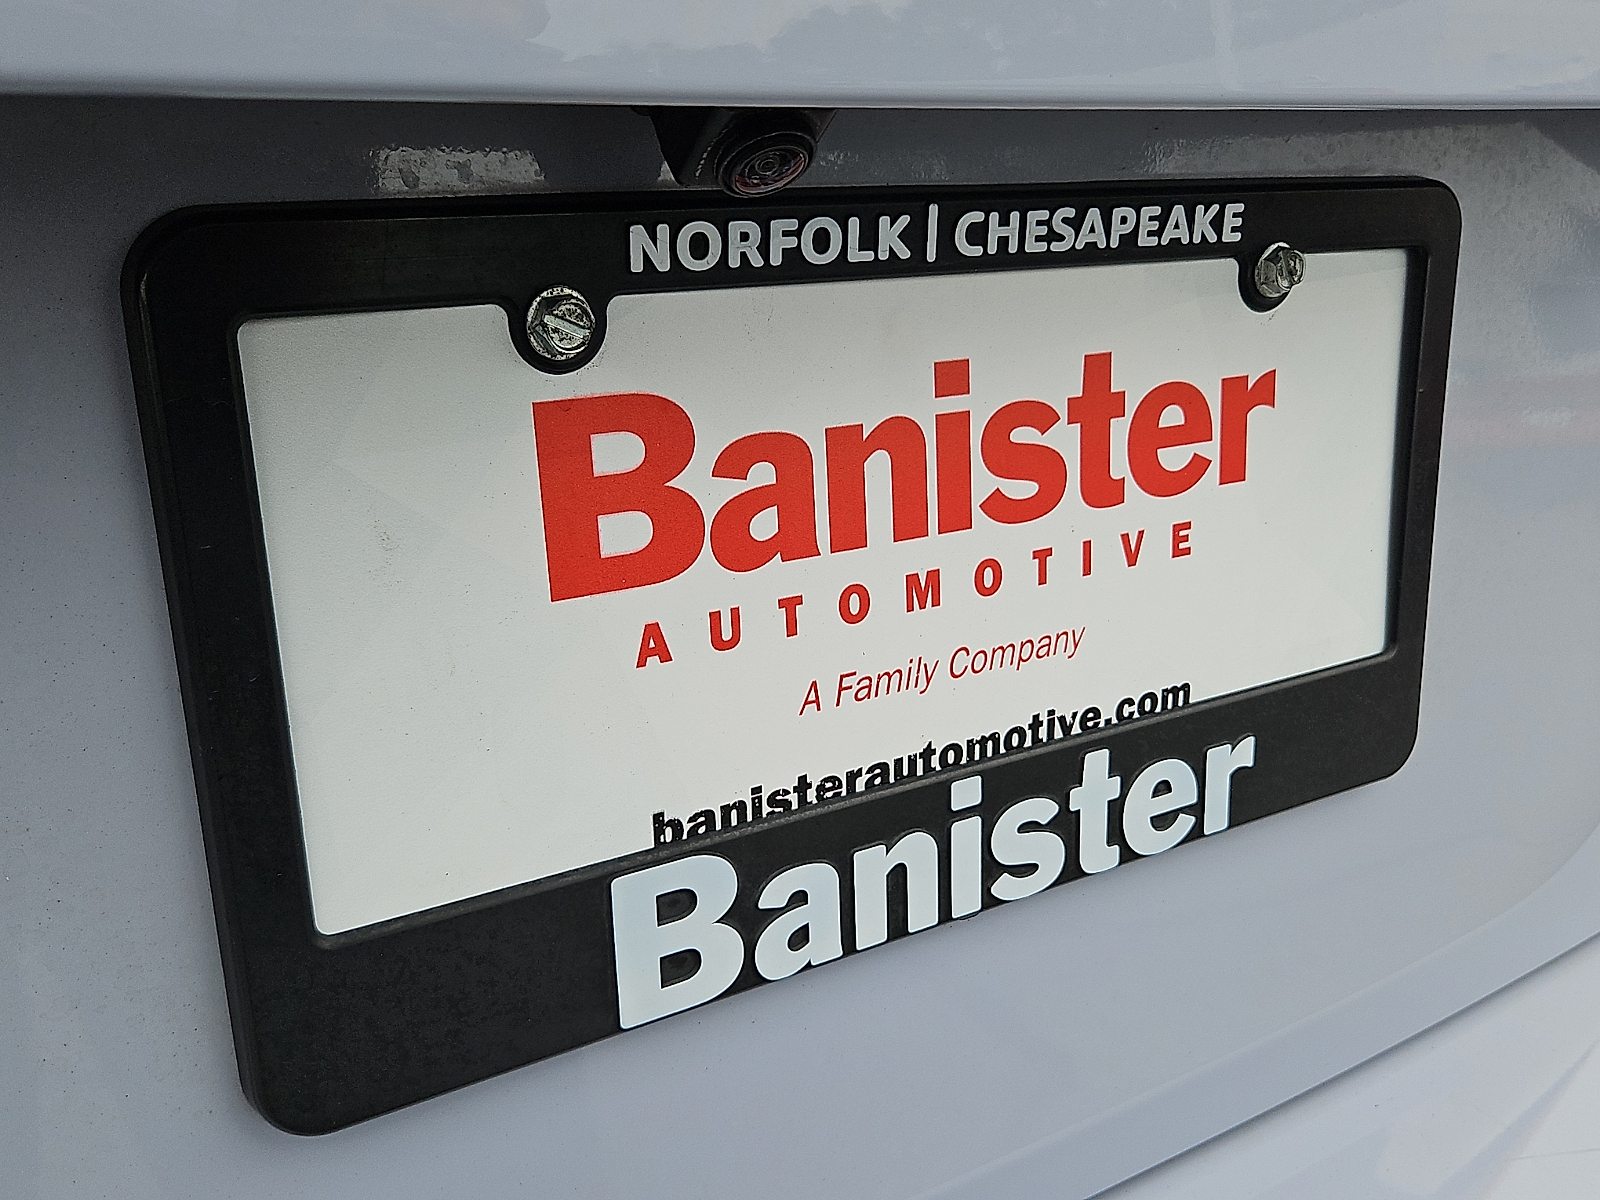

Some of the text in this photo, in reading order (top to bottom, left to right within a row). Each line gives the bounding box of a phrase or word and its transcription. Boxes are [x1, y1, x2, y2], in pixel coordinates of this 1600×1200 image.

[628, 213, 911, 274] NORFOLK
[954, 202, 1246, 257] CHESAPEAKE
[532, 351, 1277, 602] Banister
[636, 521, 1193, 669] AUTOMOTIVE
[799, 626, 1086, 715] A Family Company
[652, 681, 1192, 849] banisterautomotive.com
[610, 735, 1256, 1030] Banister
